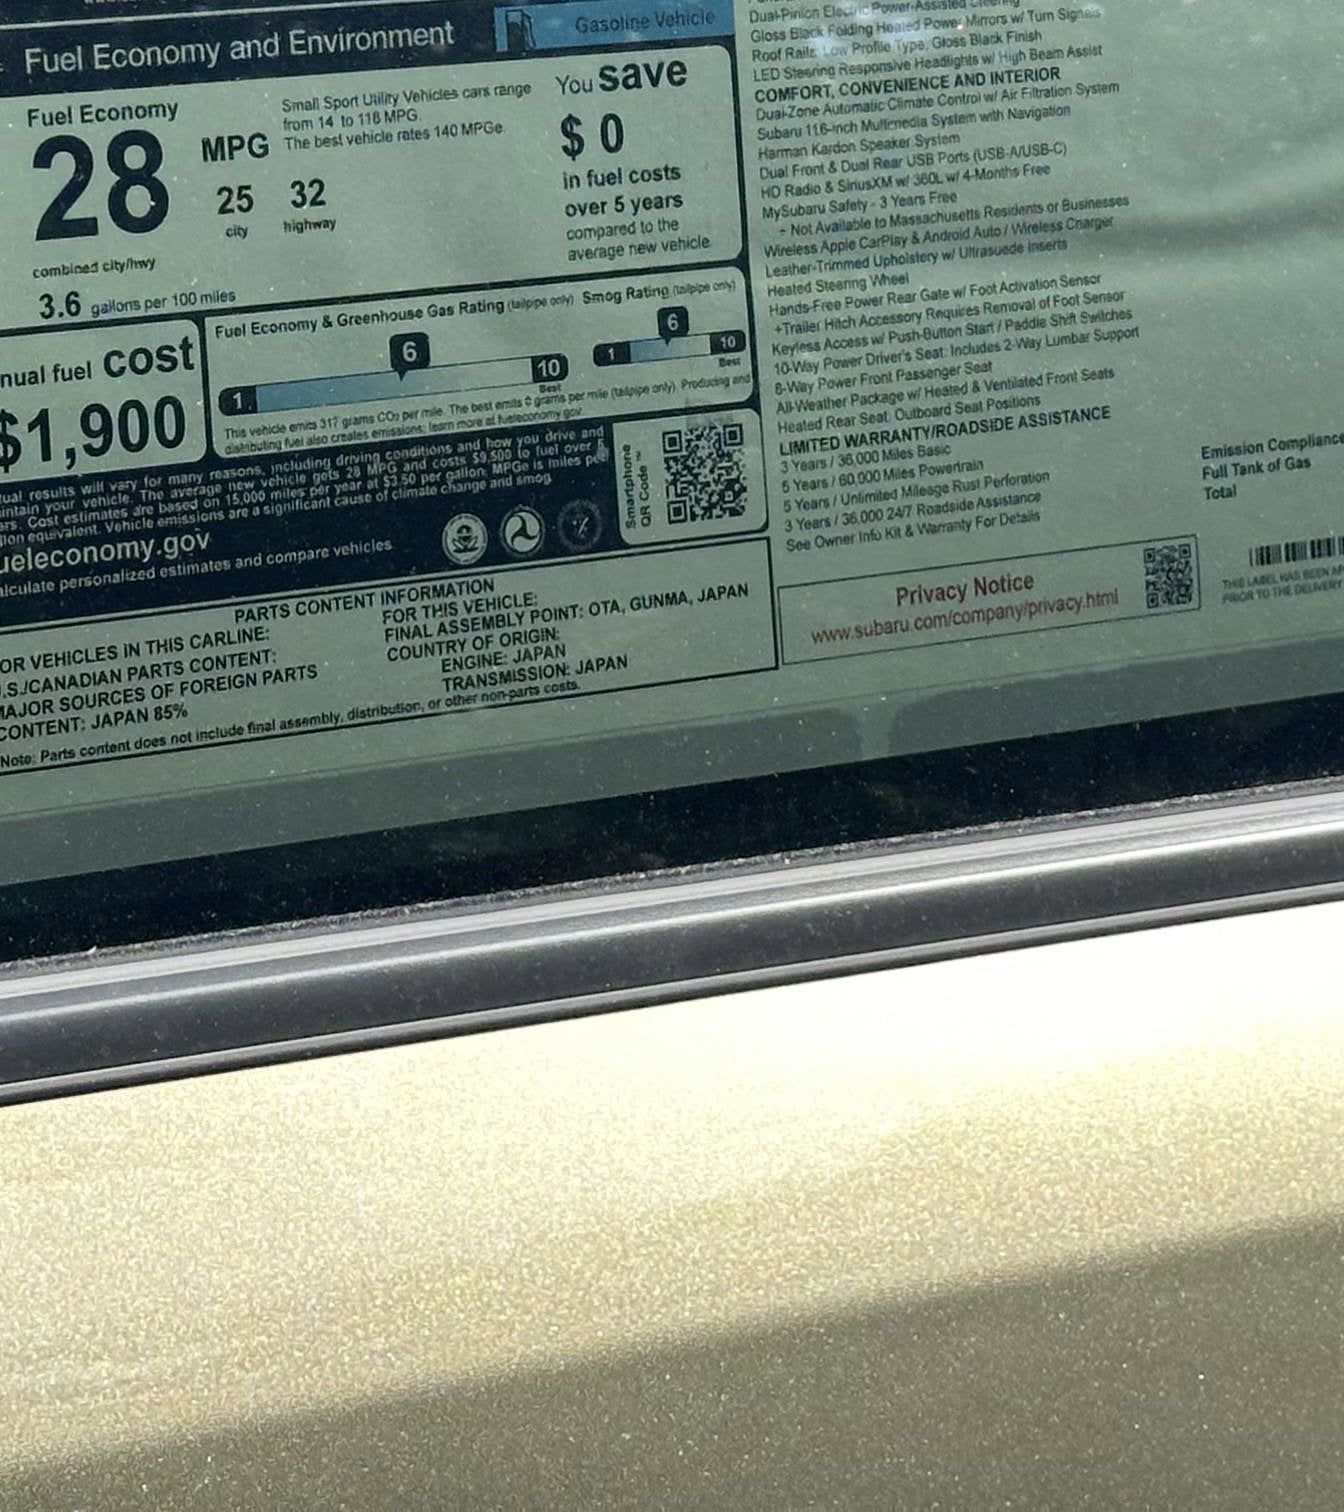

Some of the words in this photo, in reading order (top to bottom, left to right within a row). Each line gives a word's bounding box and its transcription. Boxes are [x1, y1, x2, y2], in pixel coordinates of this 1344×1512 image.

[573, 14, 651, 34] Gasoline
[652, 7, 716, 28] Vehicle
[24, 44, 83, 74] Fuel
[92, 41, 221, 70] Economy
[229, 30, 280, 60] and
[287, 19, 455, 55] Environment
[554, 73, 593, 95] You
[597, 59, 687, 92] save
[837, 73, 950, 97] CONVENIENCE
[952, 71, 986, 88] AND
[989, 65, 1061, 86] INTERIOR
[26, 104, 73, 128] Fuel
[78, 101, 178, 124] Economy
[200, 131, 270, 163] MPG
[559, 112, 585, 162] $
[599, 111, 624, 154] 0
[31, 128, 170, 241] 28
[562, 171, 581, 190] in
[585, 166, 623, 188] fuel
[627, 163, 682, 185] costs
[215, 183, 254, 215] 25
[289, 177, 327, 209] 32
[564, 200, 608, 218] over
[613, 194, 625, 213] 5
[629, 193, 684, 217] years
[224, 223, 249, 240] city
[282, 217, 337, 234] highway
[565, 220, 637, 241] compared
[639, 219, 654, 235] to
[656, 216, 680, 233] the
[567, 244, 625, 262] average
[627, 242, 657, 256] new
[659, 233, 711, 252] vehicle
[31, 260, 99, 279] combined
[101, 256, 156, 274] city/hwy
[38, 289, 81, 320] 3.6
[90, 298, 142, 319] gallons
[143, 296, 168, 313] per
[171, 290, 198, 307] 100
[199, 289, 236, 305] miles
[581, 289, 622, 305] Smog
[625, 285, 670, 300] Rating
[214, 321, 246, 339] Fuel
[249, 318, 318, 336] Economy
[321, 313, 333, 329] &
[335, 307, 424, 327] Greenhouse
[426, 302, 455, 318] Gas
[458, 298, 505, 315] Rating
[666, 312, 679, 331] 6
[401, 340, 417, 362] 6
[607, 346, 615, 361] 1
[719, 334, 736, 349] 10
[51, 359, 92, 383] fuel
[102, 334, 195, 378] cost
[536, 357, 561, 377] 10
[232, 391, 242, 409] 1
[778, 434, 841, 457] LIMITED
[843, 415, 1014, 449] WARRANTY/ROADSIDE
[1017, 404, 1111, 429] ASSISTANCE
[1200, 441, 1265, 460] Emission
[636, 464, 650, 502] Code
[1201, 462, 1228, 481] Full
[1229, 459, 1265, 477] Tank
[1266, 456, 1281, 473] of
[1283, 455, 1312, 471] Gas
[621, 443, 637, 529] Smartphone
[1202, 482, 1237, 500] Total
[638, 503, 652, 528] QR
[58, 564, 156, 594] personalized
[158, 558, 231, 578] estimates
[234, 551, 262, 569] and
[265, 546, 330, 565] compare
[332, 537, 393, 557] vehicles
[233, 602, 291, 624] PARTS
[294, 591, 375, 616] CONTENT
[379, 577, 495, 606] INFORMATION
[895, 582, 968, 607] Privacy
[972, 572, 1034, 597] Notice
[381, 605, 418, 625] FOR
[419, 600, 459, 619] THIS
[461, 590, 538, 615] VEHICLE:
[383, 622, 433, 643] FINAL
[436, 609, 525, 637] ASSEMBLY
[529, 603, 583, 625] POINT:
[587, 598, 626, 617] OTA,
[628, 589, 693, 612] GUNMA,
[696, 582, 749, 603] JAPAN
[810, 586, 1119, 645] www.subaru.com/company/privacy.html
[29, 643, 118, 670] VEHICLES
[122, 641, 141, 659] IN
[144, 635, 184, 655] THIS
[188, 624, 269, 650] CARLINE:
[386, 636, 467, 662] COUNTRY
[470, 633, 494, 651] OF
[498, 625, 560, 648] ORIGIN:
[440, 650, 508, 673] ENGINE:
[511, 642, 566, 664] JAPAN
[126, 659, 185, 682] PARTS
[188, 647, 276, 673] CONTENT:
[441, 661, 571, 693] TRANSMISSION:
[574, 653, 628, 675] JAPAN
[58, 685, 146, 712] SOURCES
[149, 682, 174, 700] OF
[178, 671, 257, 697] FOREIGN
[261, 663, 318, 686] PARTS
[90, 706, 149, 730] JAPAN
[152, 702, 188, 722] 85%
